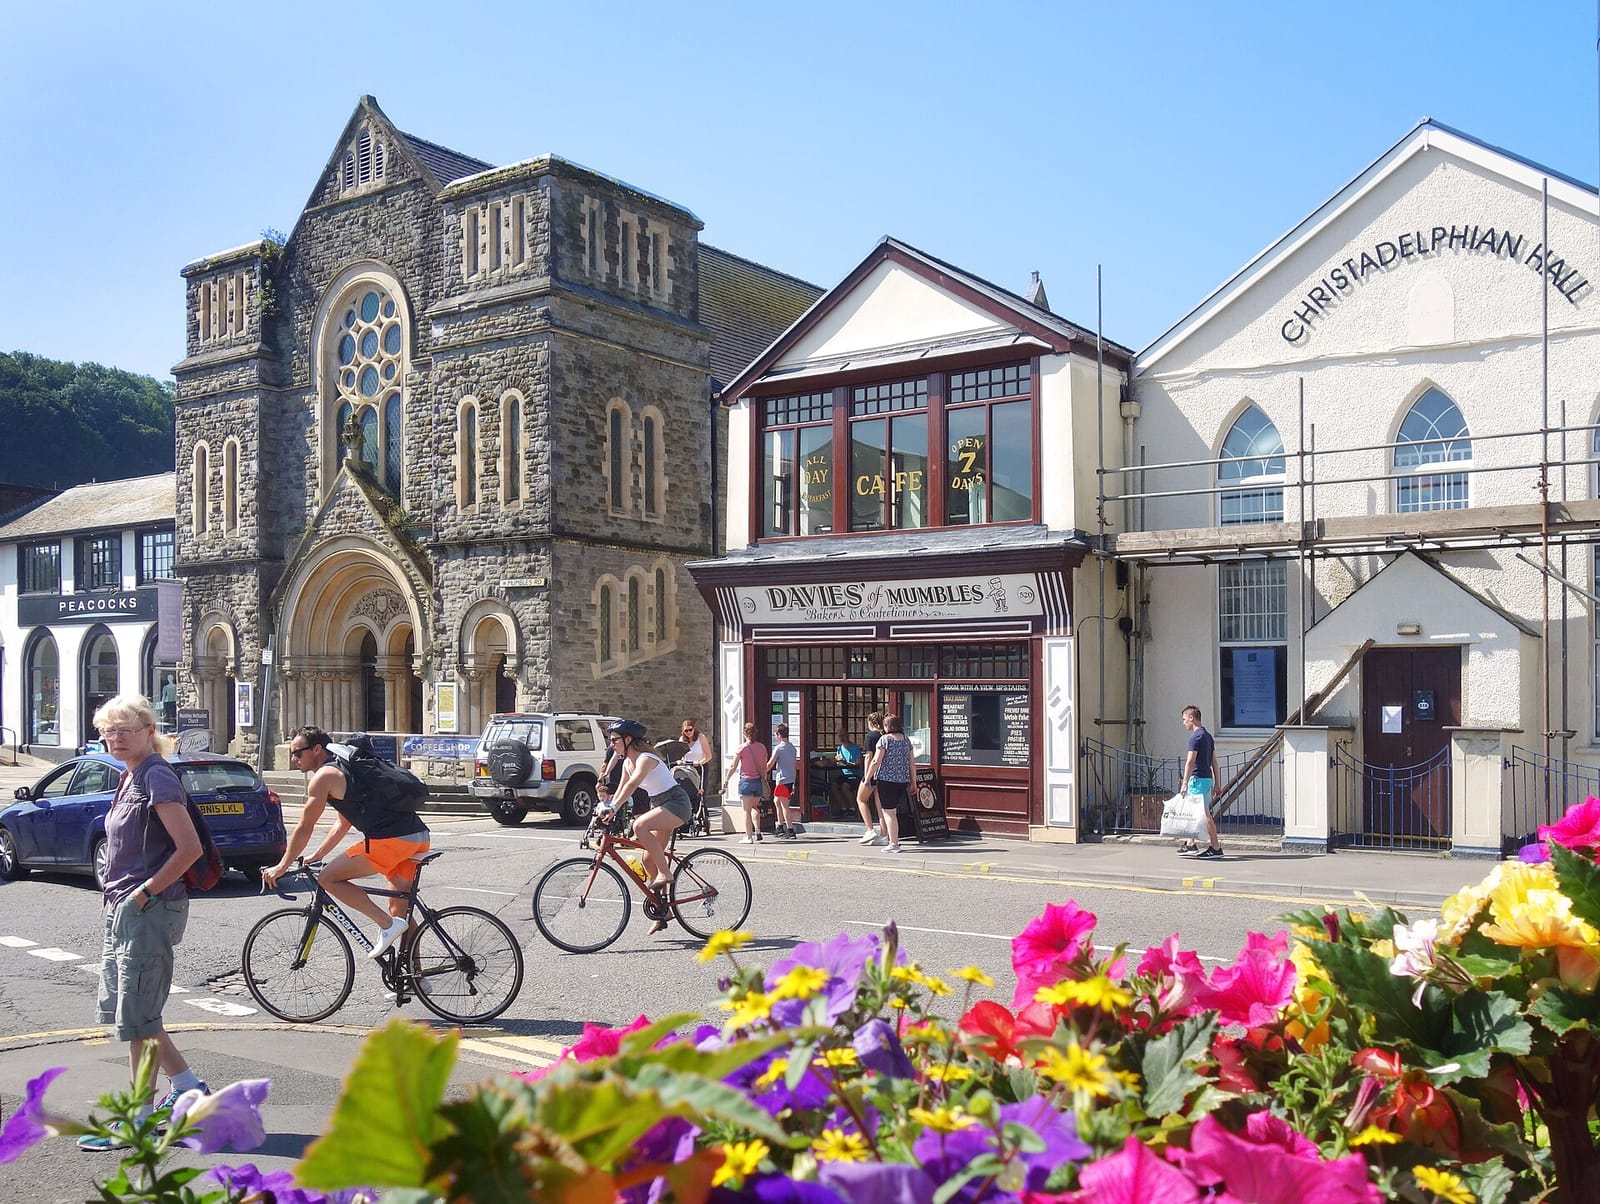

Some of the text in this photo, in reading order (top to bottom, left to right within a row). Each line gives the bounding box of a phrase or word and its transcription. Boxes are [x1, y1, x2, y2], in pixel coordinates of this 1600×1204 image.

[1281, 225, 1590, 343] CHRISTADELPHIAN HALL
[951, 438, 984, 453] OPEN
[806, 455, 826, 467] ALL
[958, 451, 976, 473] 7
[804, 469, 828, 484] DAY
[856, 470, 923, 496] CAFE
[951, 472, 984, 490] DAYS
[59, 597, 137, 612] PEACOCKS
[766, 583, 984, 611] DAVIES' of MUMBLES
[805, 608, 845, 621] Bakers
[860, 606, 926, 620] Confectioners
[410, 743, 471, 752] COFFEE SHOP
[200, 804, 240, 814] BN15 LKL
[331, 907, 372, 951] boardma
